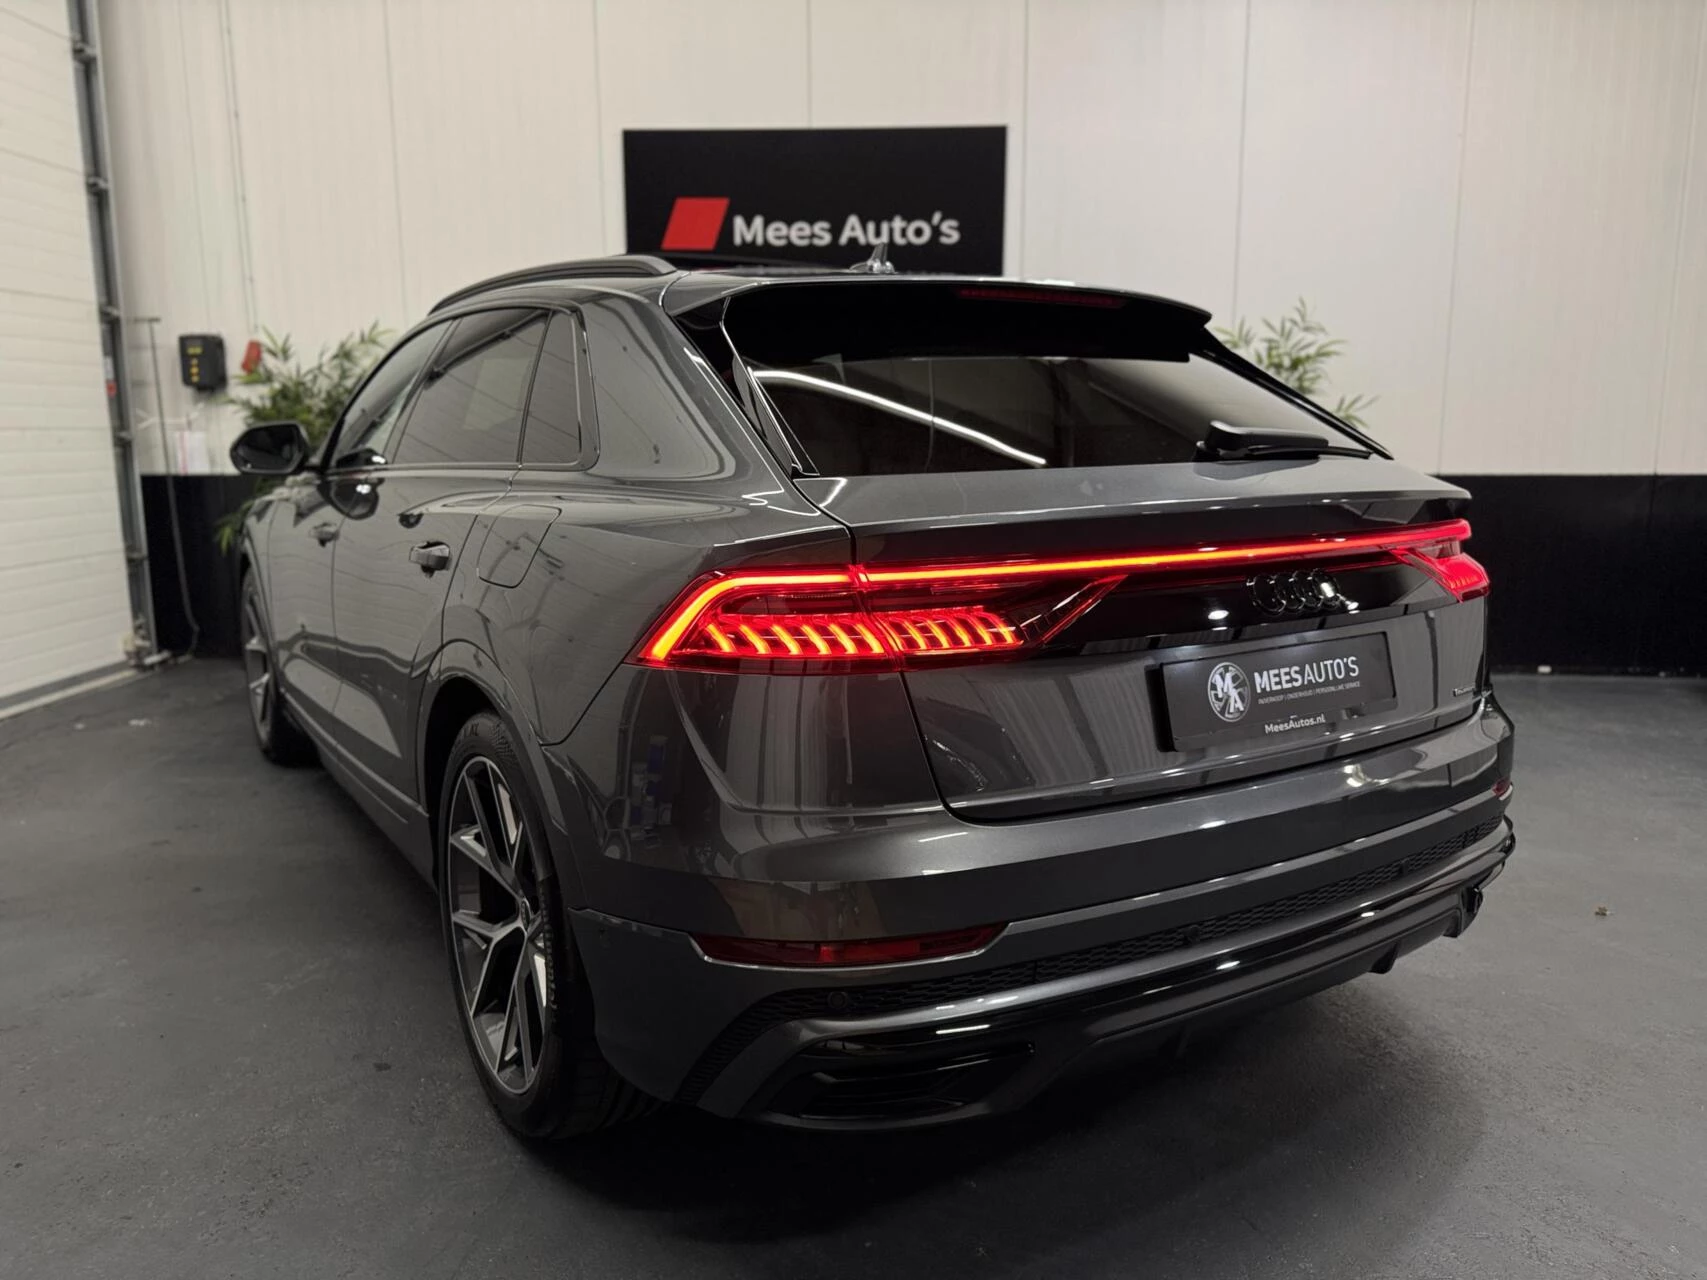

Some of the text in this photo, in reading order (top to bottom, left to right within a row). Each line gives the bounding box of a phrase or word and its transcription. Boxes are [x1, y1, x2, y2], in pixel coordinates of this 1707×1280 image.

[733, 211, 961, 247] Mees Auto's
[1265, 714, 1326, 734] MeesAutos.nl
